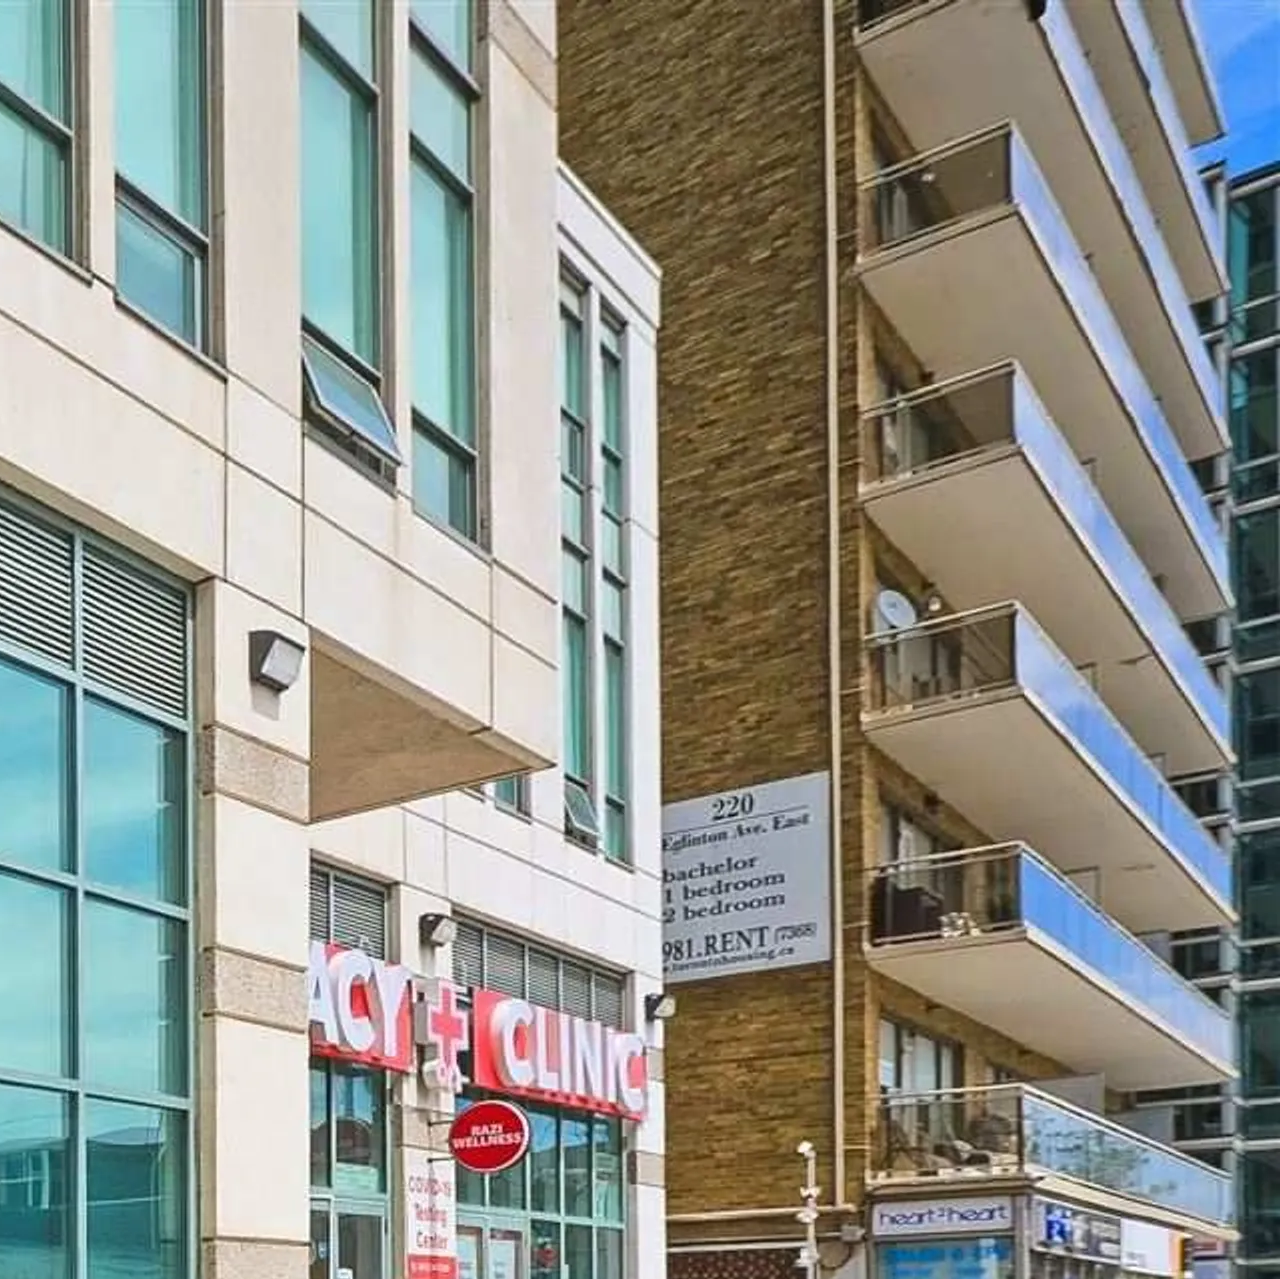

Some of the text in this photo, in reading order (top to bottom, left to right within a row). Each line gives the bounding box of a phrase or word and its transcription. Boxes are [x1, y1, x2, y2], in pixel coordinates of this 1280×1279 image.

[711, 793, 755, 822] 220
[732, 825, 768, 840] Ave.
[773, 813, 810, 831] East
[663, 856, 758, 884] bachelor
[683, 873, 786, 901] bedroom
[663, 892, 786, 924] 2 bedroom
[491, 997, 646, 1113] CLINIC
[452, 1132, 522, 1150] WELLNESS
[471, 1123, 504, 1137] RAZI
